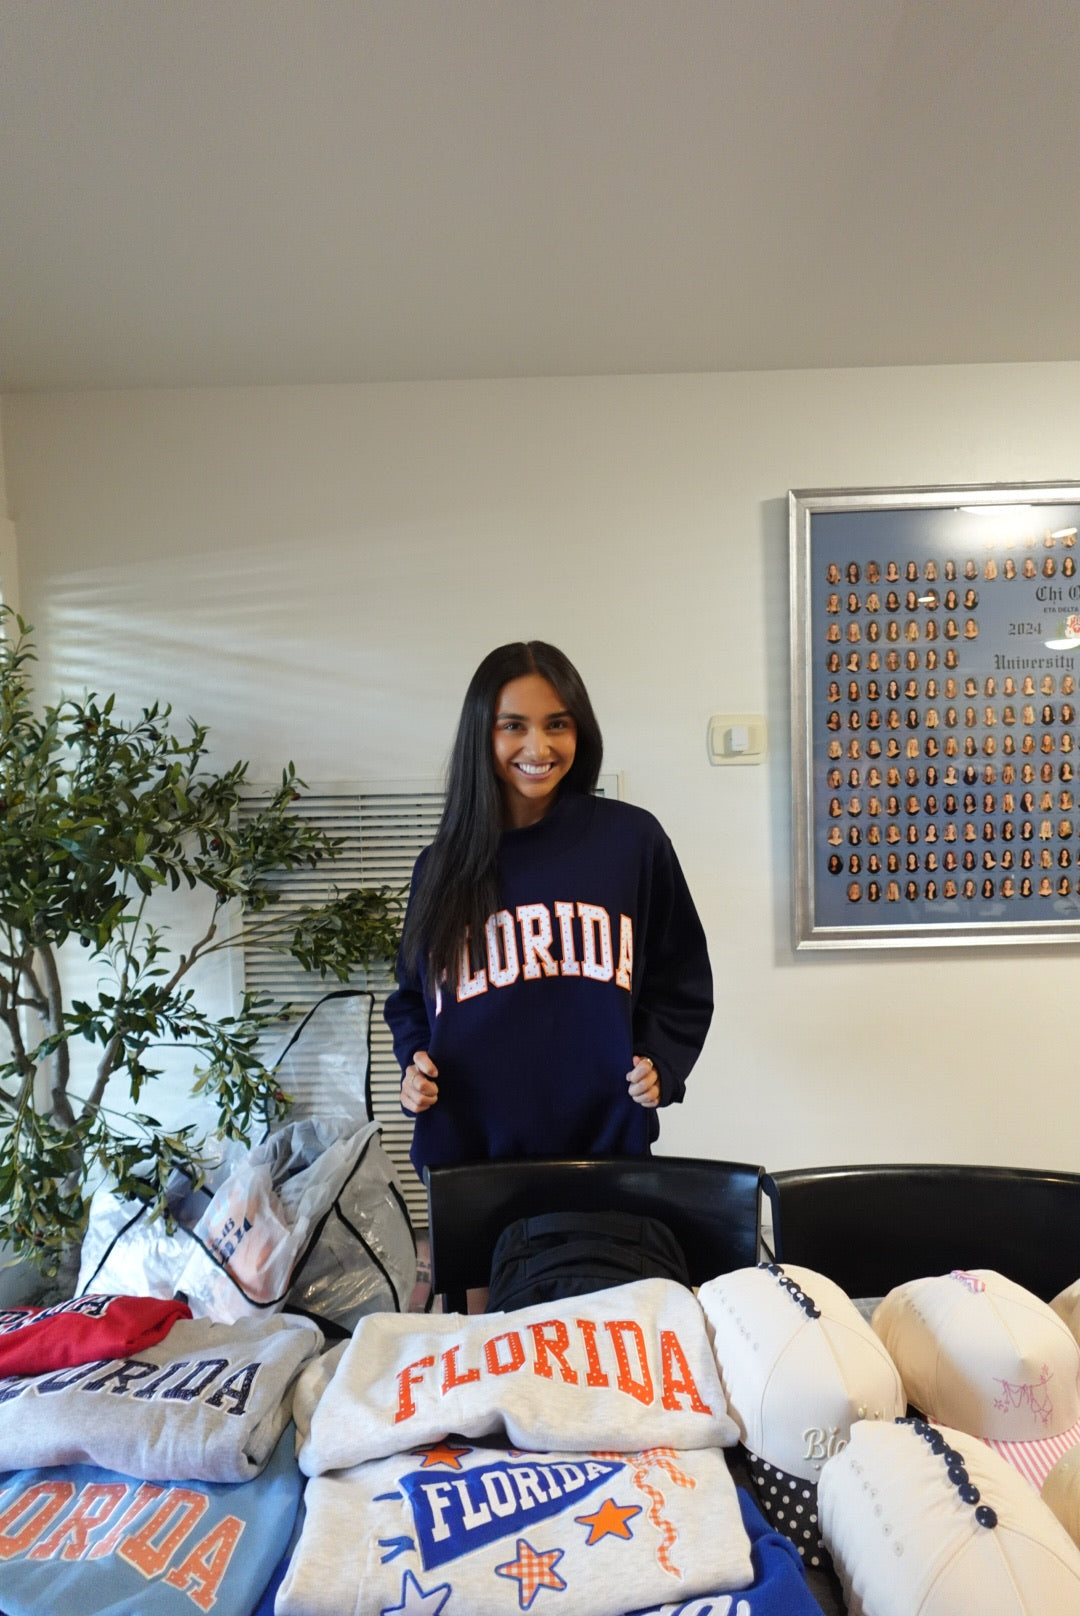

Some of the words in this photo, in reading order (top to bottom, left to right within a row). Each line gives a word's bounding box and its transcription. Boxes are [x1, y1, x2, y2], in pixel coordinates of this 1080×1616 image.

[1008, 622, 1042, 635] 2024
[1036, 585, 1063, 604] Chi
[994, 653, 1074, 671] University
[430, 901, 633, 1017] LORIDA
[393, 1319, 713, 1424] FLORIDA
[421, 1459, 613, 1542] FLORIDA
[0, 1480, 246, 1612] ORIDA
